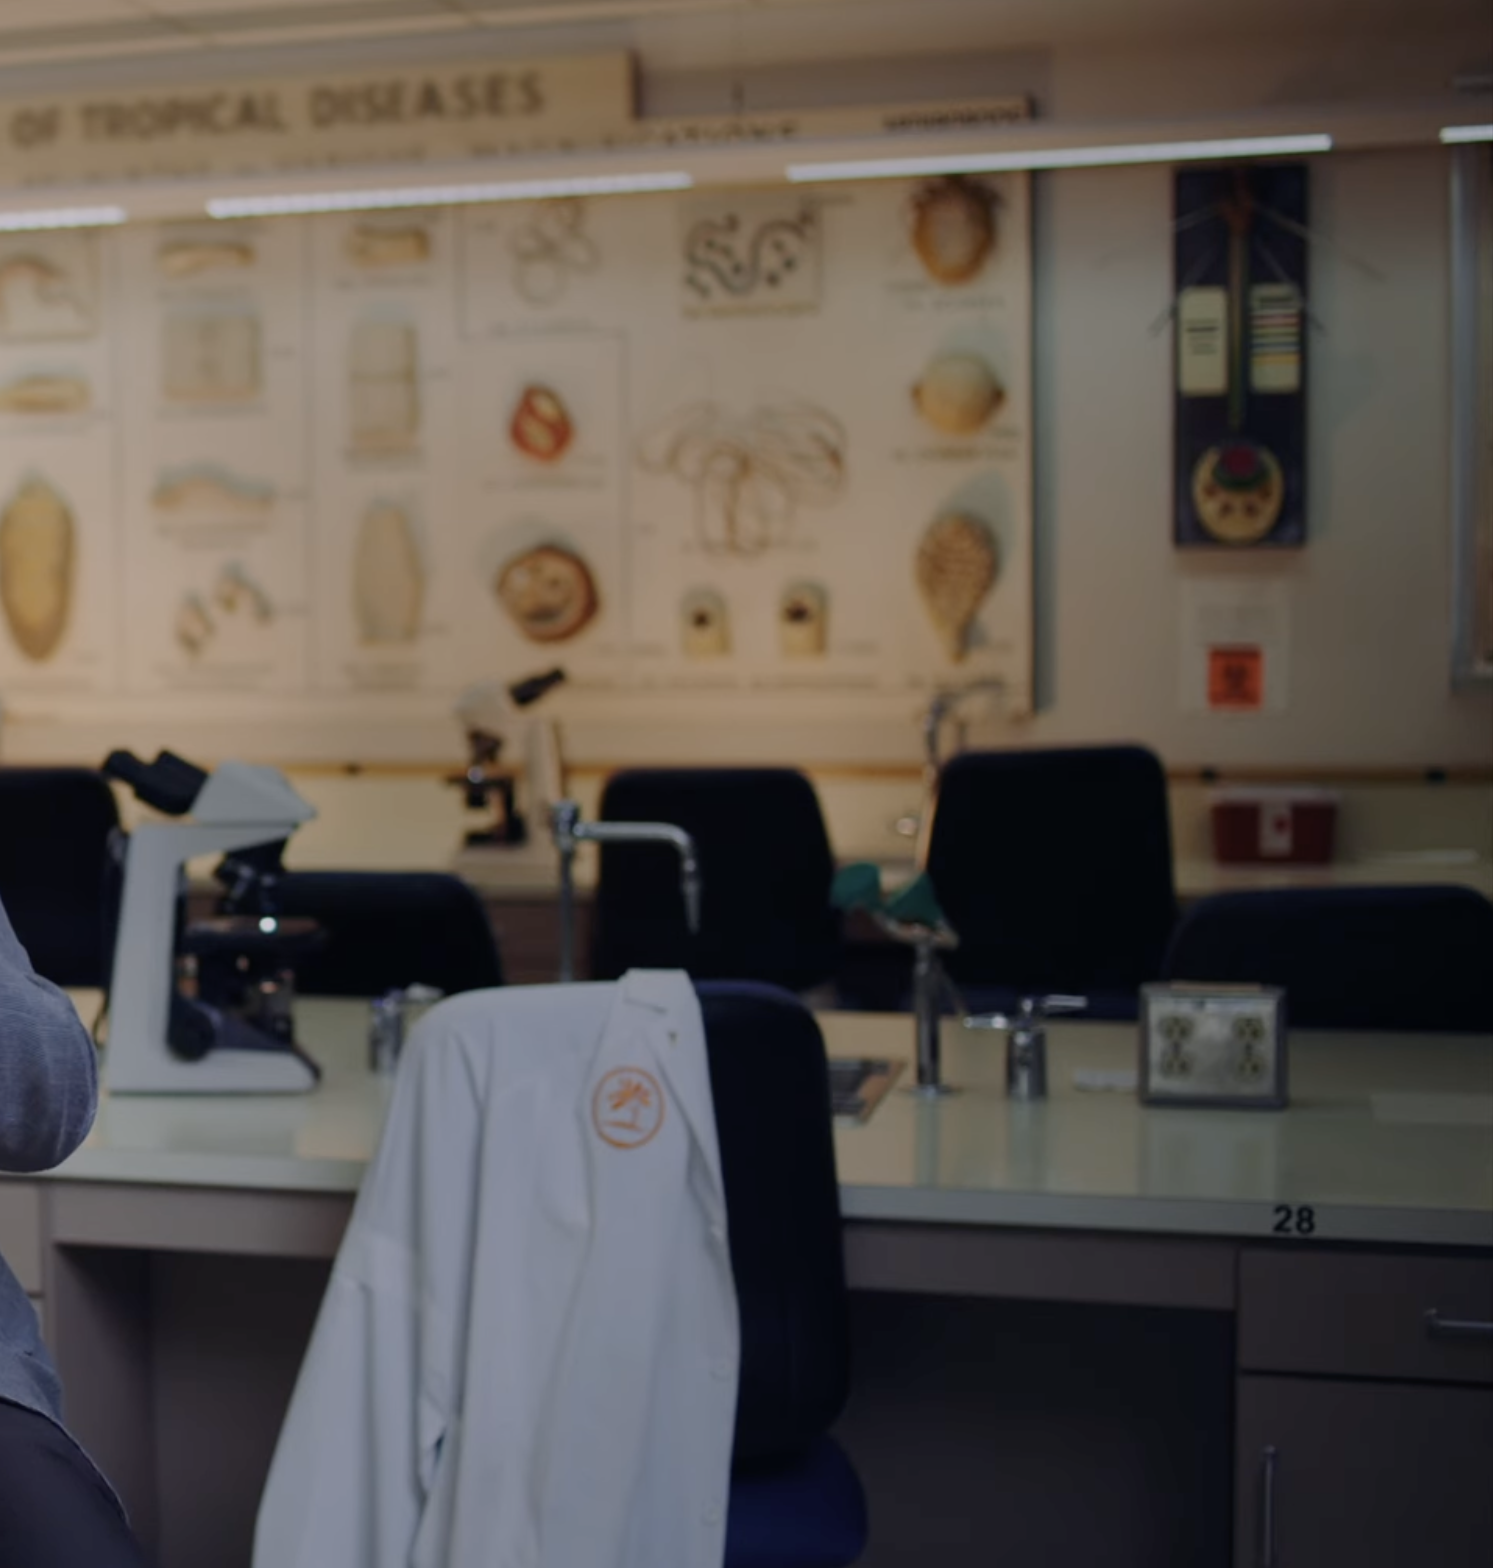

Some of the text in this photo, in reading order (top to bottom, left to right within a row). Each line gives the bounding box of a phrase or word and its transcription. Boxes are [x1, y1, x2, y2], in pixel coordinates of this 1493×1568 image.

[12, 104, 61, 147] OF
[81, 91, 285, 141] TROPICAL
[311, 70, 545, 128] DISEASES
[1273, 1203, 1316, 1234] 28
